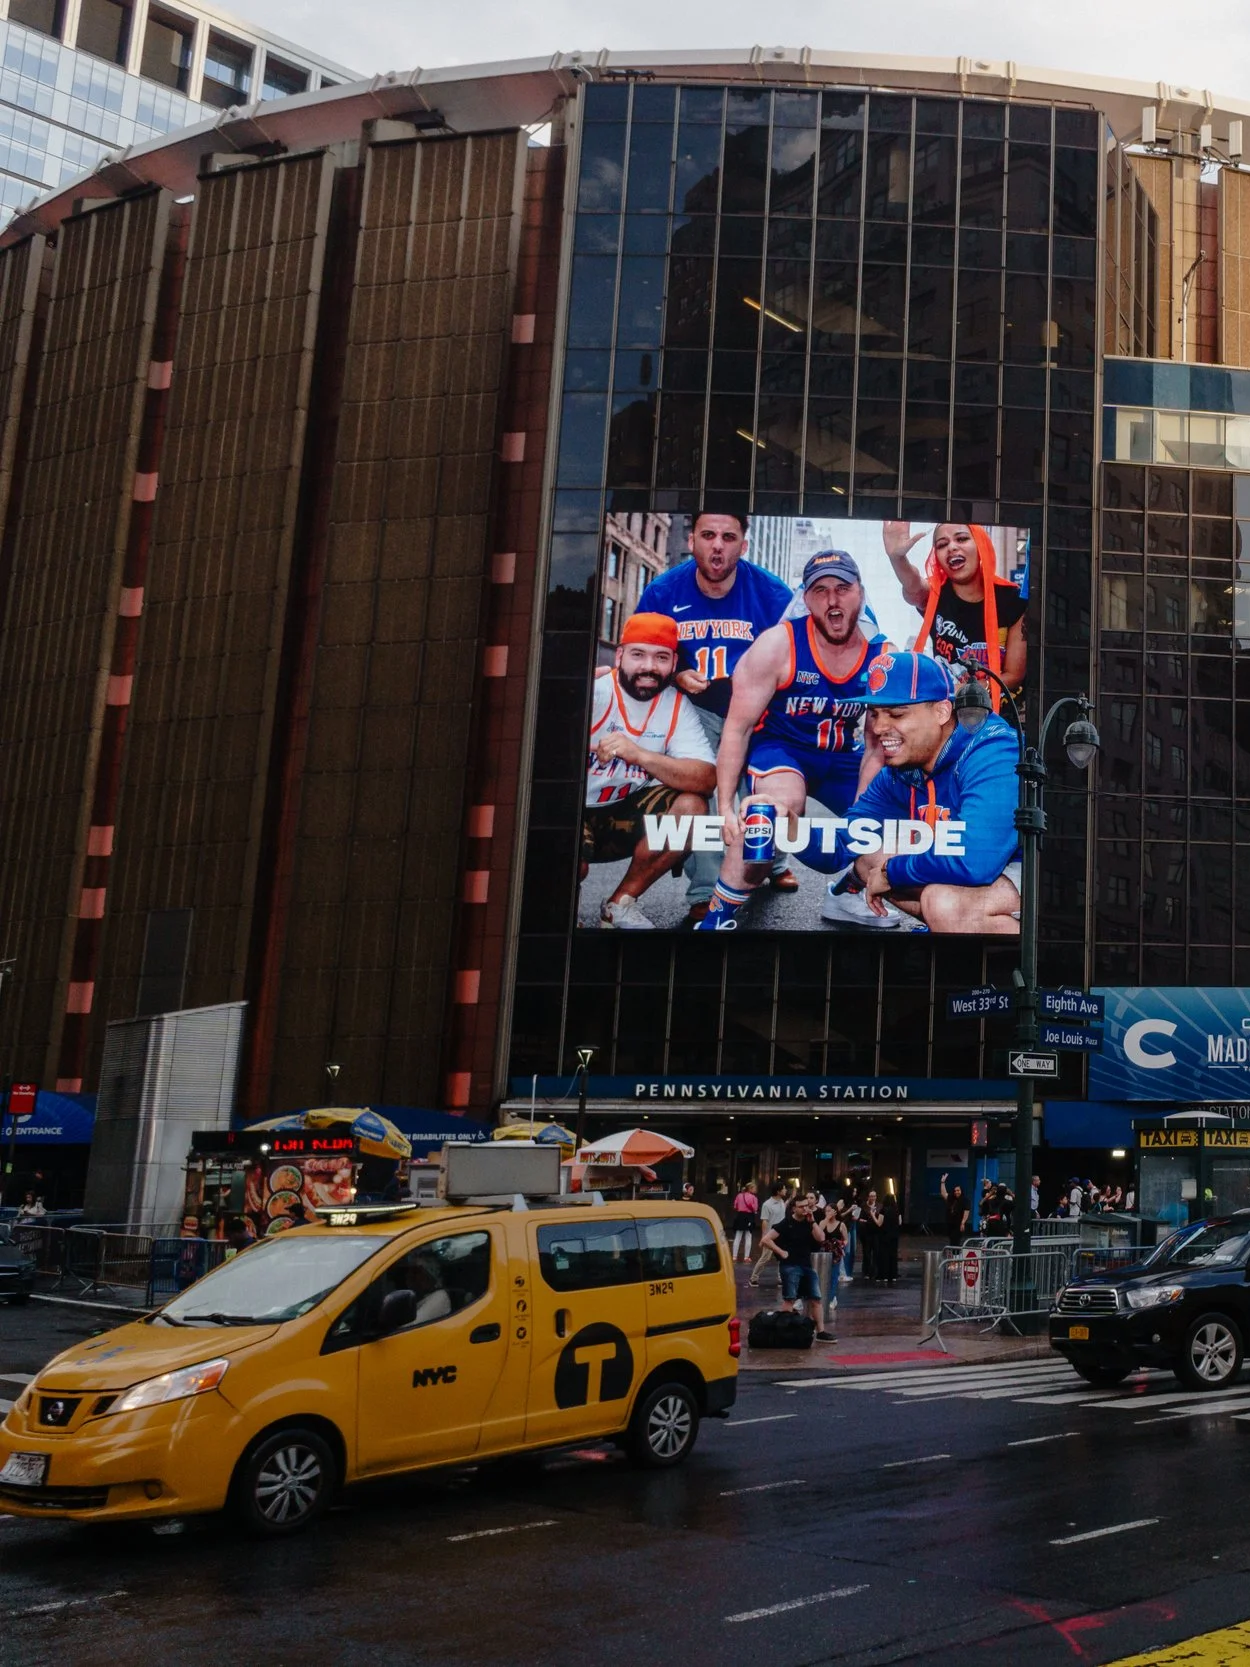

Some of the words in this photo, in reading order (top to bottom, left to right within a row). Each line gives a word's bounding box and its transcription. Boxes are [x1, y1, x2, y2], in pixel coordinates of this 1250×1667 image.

[709, 619, 754, 641] YORK
[696, 646, 730, 682] 11
[796, 672, 820, 685] NYC
[786, 697, 828, 716] NEW
[817, 719, 846, 753] 11
[644, 814, 726, 852] WE
[952, 1000, 976, 1013] West
[978, 995, 996, 1011] 33rd
[999, 996, 1009, 1009] St
[1046, 995, 1077, 1012] Eighth
[1079, 1000, 1098, 1014] Ave
[1045, 1030, 1060, 1043] Joe
[1062, 1031, 1083, 1045] Louis
[1085, 1037, 1098, 1046] Plaza
[1123, 1018, 1178, 1069] C
[1017, 1058, 1031, 1068] ONE
[1036, 1059, 1051, 1069] WAY
[635, 1083, 808, 1099] PENNSYLVANIA
[819, 1085, 909, 1099] STATION
[16, 1127, 62, 1135] ENTRANCE
[412, 1133, 457, 1141] DISABILITIES
[458, 1132, 477, 1141] ONLY
[1143, 1131, 1178, 1146] TAXI
[1206, 1130, 1237, 1145] TAXI
[330, 1213, 358, 1226] 3N29
[649, 1281, 674, 1296] 3N29
[412, 1365, 457, 1388] NYC
[574, 1341, 617, 1406] T
